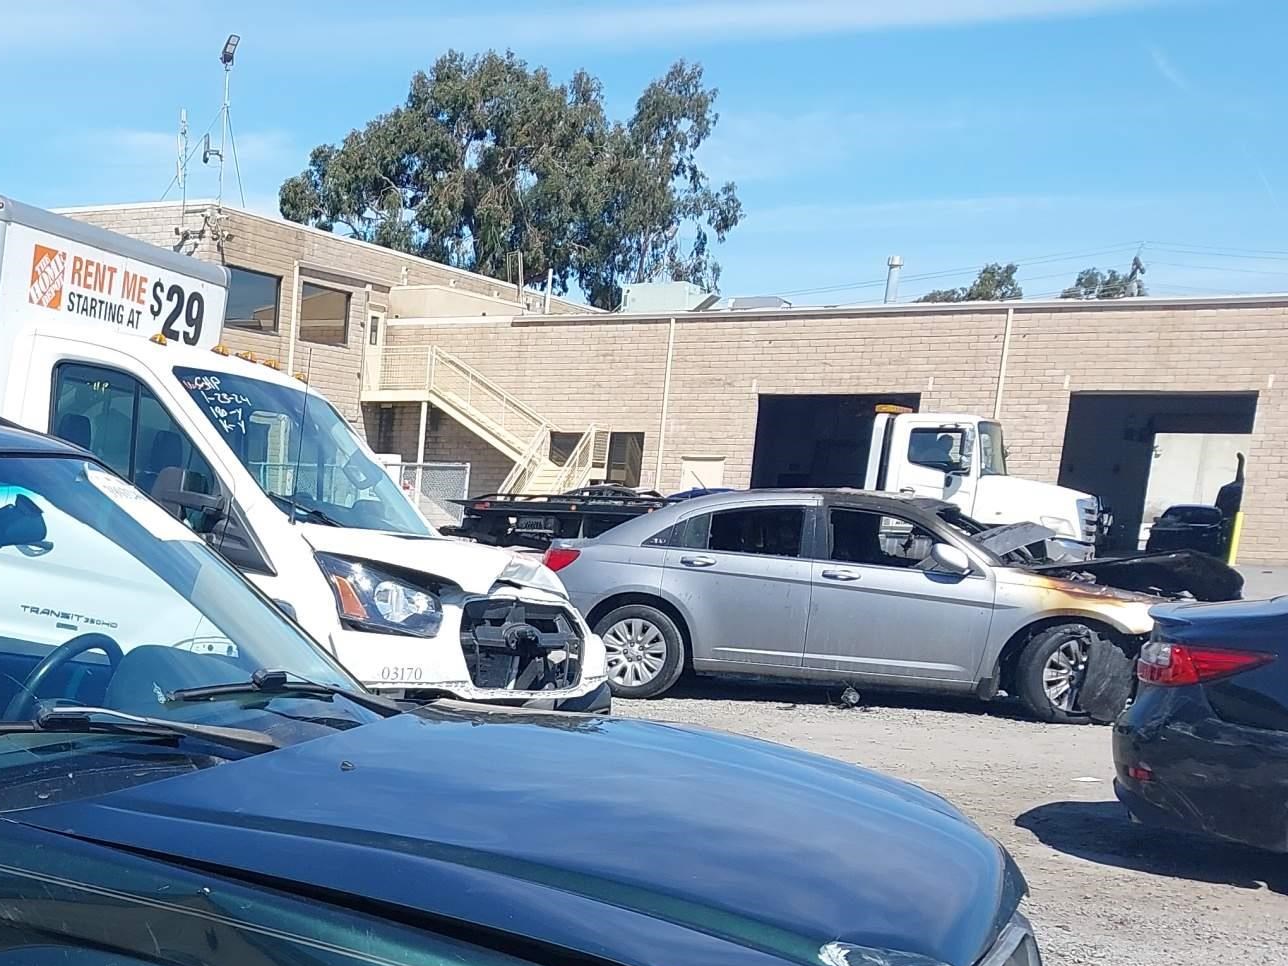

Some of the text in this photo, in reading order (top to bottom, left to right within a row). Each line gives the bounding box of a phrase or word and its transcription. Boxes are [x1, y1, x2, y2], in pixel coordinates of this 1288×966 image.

[67, 291, 143, 330] STARTING AT
[71, 255, 205, 346] RENT ME $29
[20, 604, 84, 622] TRANSIT
[381, 666, 423, 681] 03170
